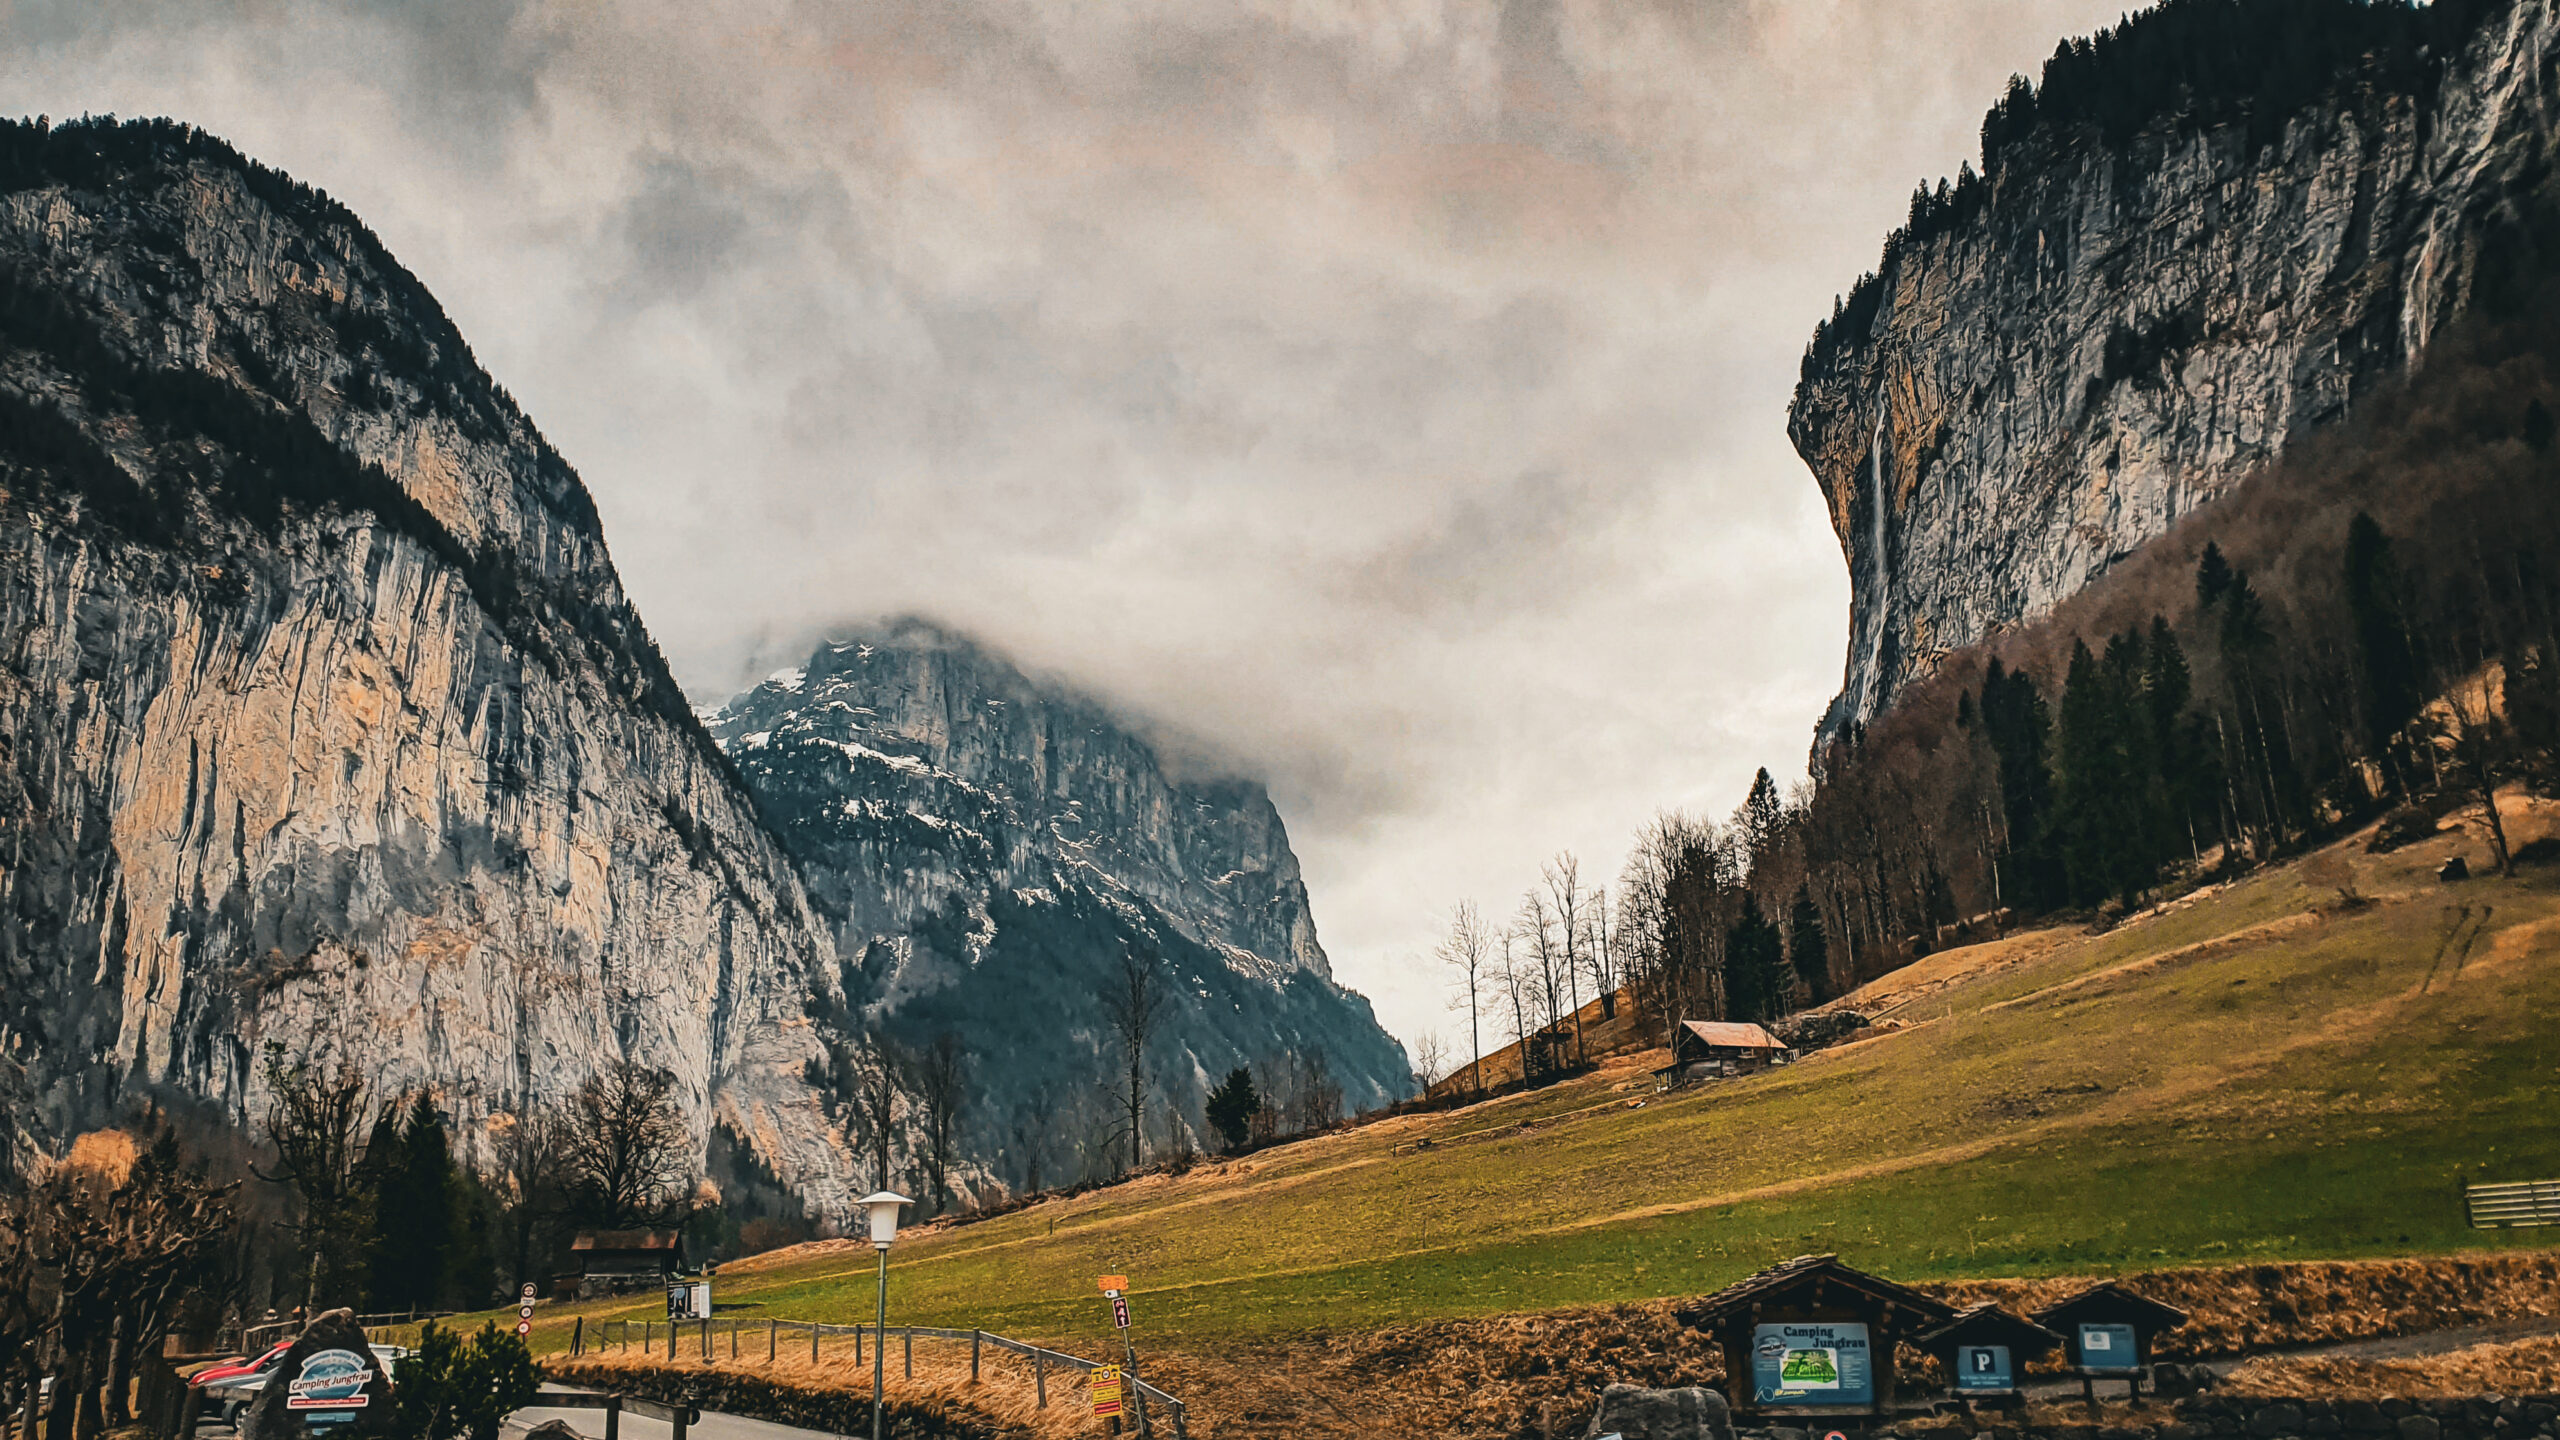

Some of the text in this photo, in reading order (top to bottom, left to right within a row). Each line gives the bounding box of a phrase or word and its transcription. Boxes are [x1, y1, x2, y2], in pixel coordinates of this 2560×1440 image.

[1784, 1326, 1834, 1338] Camping
[1812, 1337, 1866, 1349] Jungfrau
[1976, 1353, 1990, 1371] P
[292, 1373, 370, 1391] Camping Jungfrau
